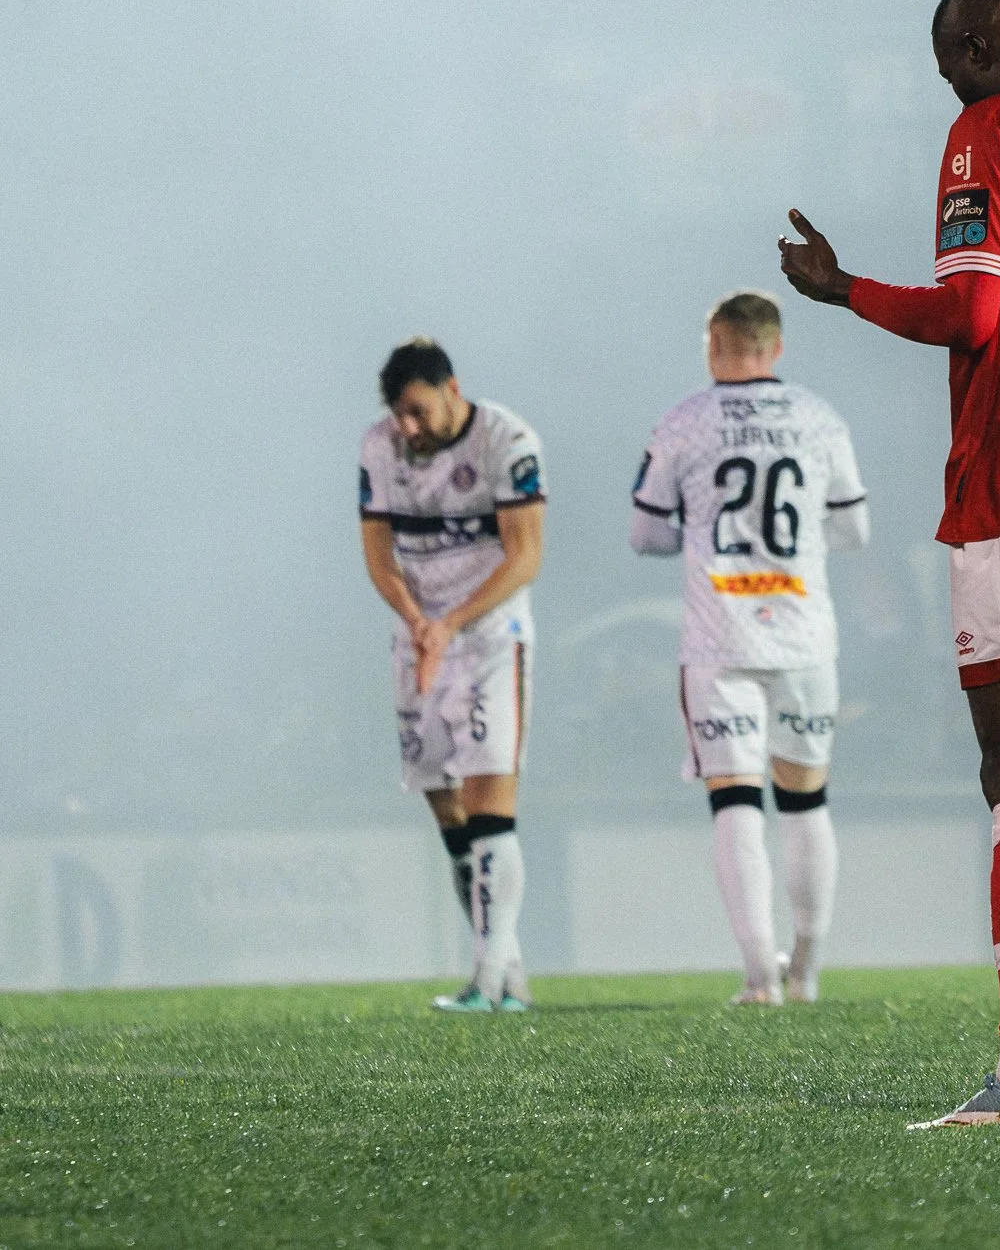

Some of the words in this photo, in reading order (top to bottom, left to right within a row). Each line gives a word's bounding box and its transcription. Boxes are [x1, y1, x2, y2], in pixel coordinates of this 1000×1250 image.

[952, 145, 972, 181] ej
[954, 206, 984, 217] Airtricity
[955, 197, 971, 208] sse
[713, 456, 804, 558] 26
